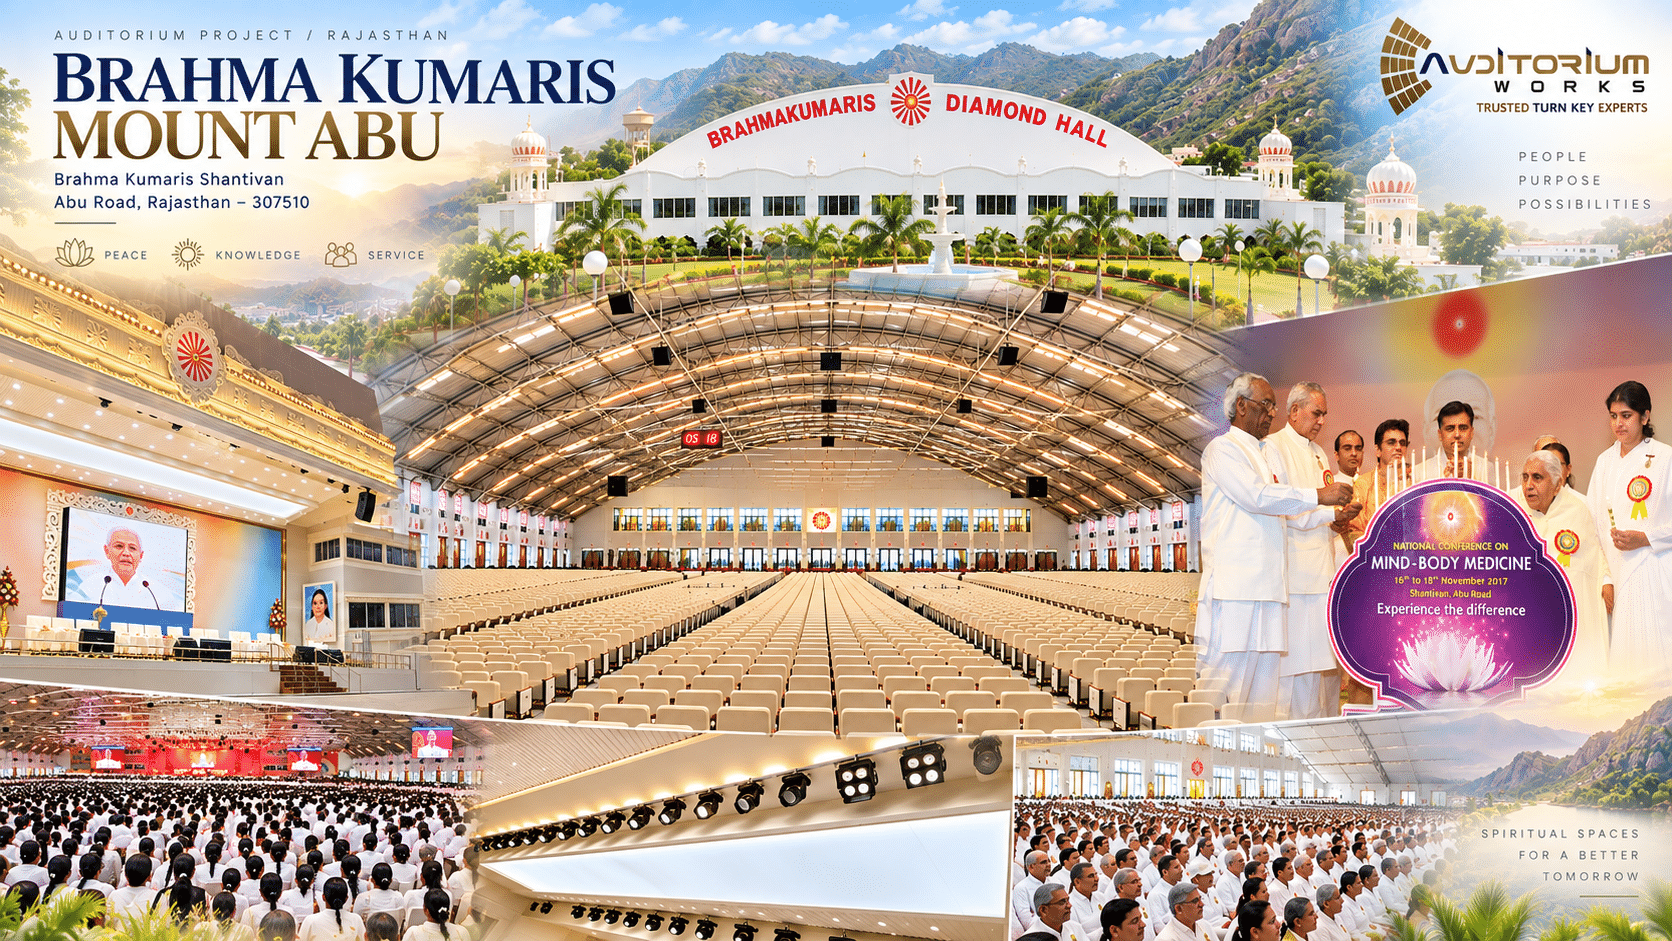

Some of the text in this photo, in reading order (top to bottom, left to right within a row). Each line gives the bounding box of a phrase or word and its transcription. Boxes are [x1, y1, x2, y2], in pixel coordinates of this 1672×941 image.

[706, 93, 1108, 149] BRAHMAKUMARIS DIAMOND HALL
[706, 433, 717, 443] 18
[1393, 542, 1509, 551] NATIONAL CONFERENCE ON
[1464, 556, 1532, 571] MEDICINE
[1412, 576, 1421, 585] to
[1441, 576, 1485, 586] November
[1487, 577, 1509, 586] 2017
[1452, 589, 1469, 598] Abu
[1377, 602, 1526, 617] Experience the difference
